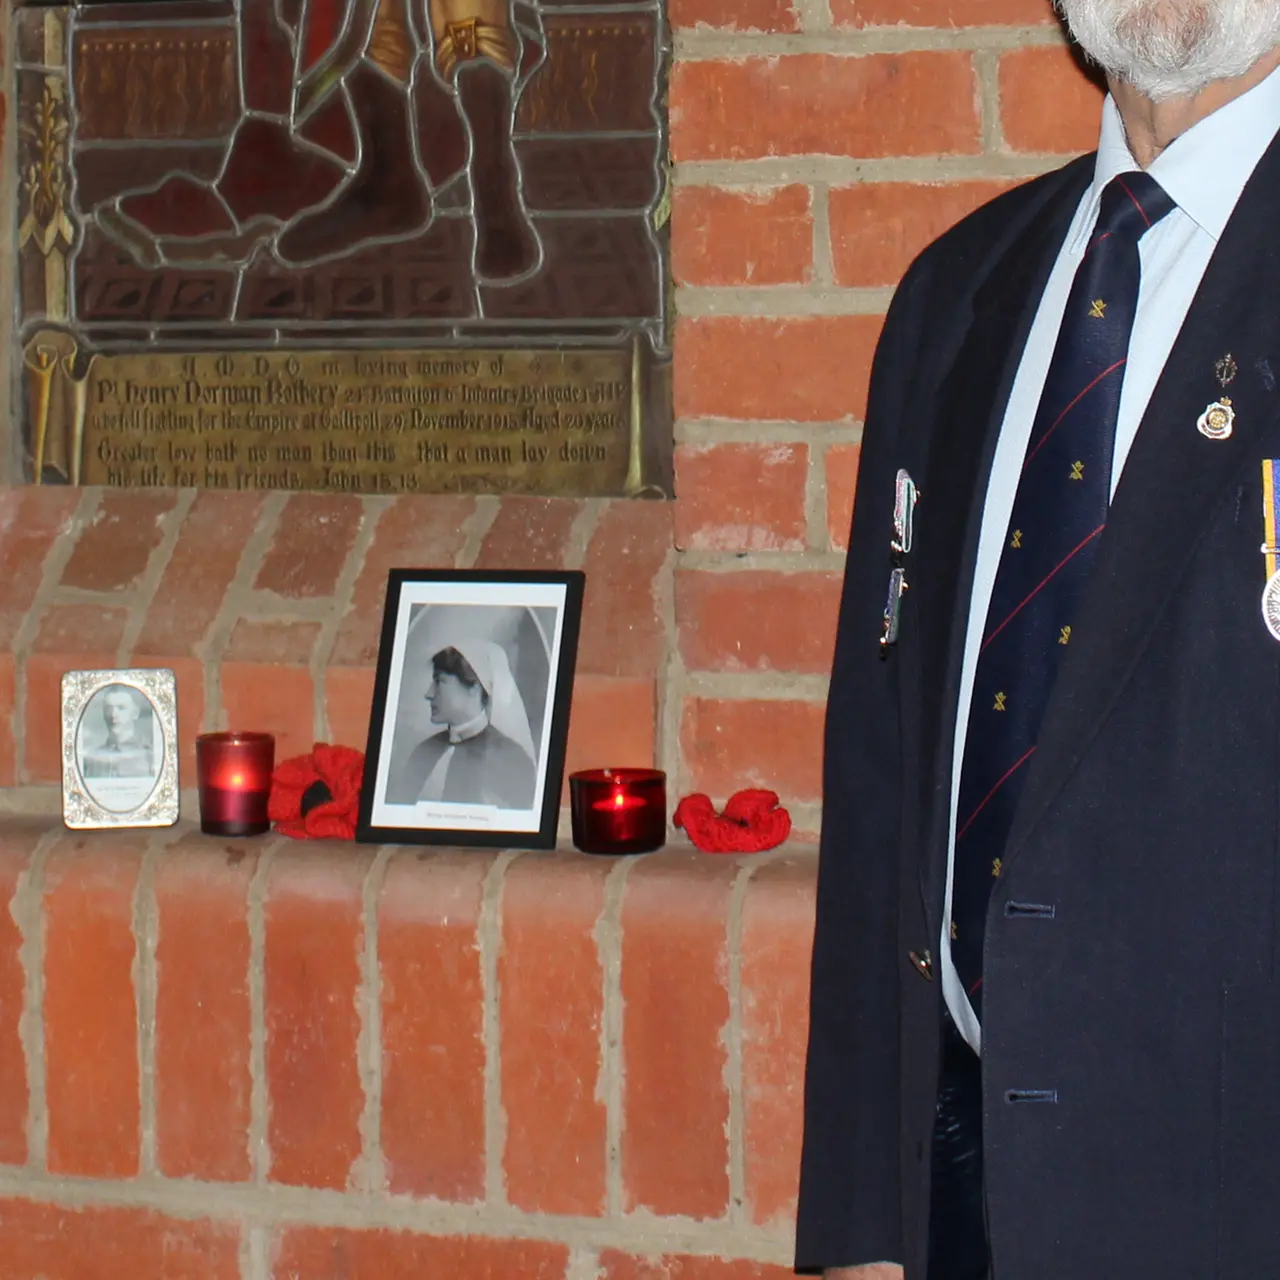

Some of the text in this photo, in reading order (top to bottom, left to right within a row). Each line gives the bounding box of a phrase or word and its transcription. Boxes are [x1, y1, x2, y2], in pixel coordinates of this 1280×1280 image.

[354, 355, 409, 379] loving
[417, 359, 480, 377] memory
[490, 355, 505, 376] of
[142, 407, 195, 434] fighting
[198, 407, 217, 433] for
[221, 408, 242, 430] the
[302, 410, 318, 430] at
[410, 407, 483, 431] November
[97, 436, 158, 466] Greater
[205, 438, 238, 463] hath
[248, 444, 267, 465] no
[277, 443, 312, 462] man
[322, 439, 358, 463] than
[366, 438, 396, 463] this
[417, 439, 449, 464] that
[456, 445, 468, 464] a
[475, 443, 512, 464] man
[522, 438, 550, 466] lay
[559, 440, 607, 464] down
[140, 465, 166, 488] life
[173, 466, 197, 488] for
[204, 465, 230, 489] his
[320, 468, 362, 491] John
